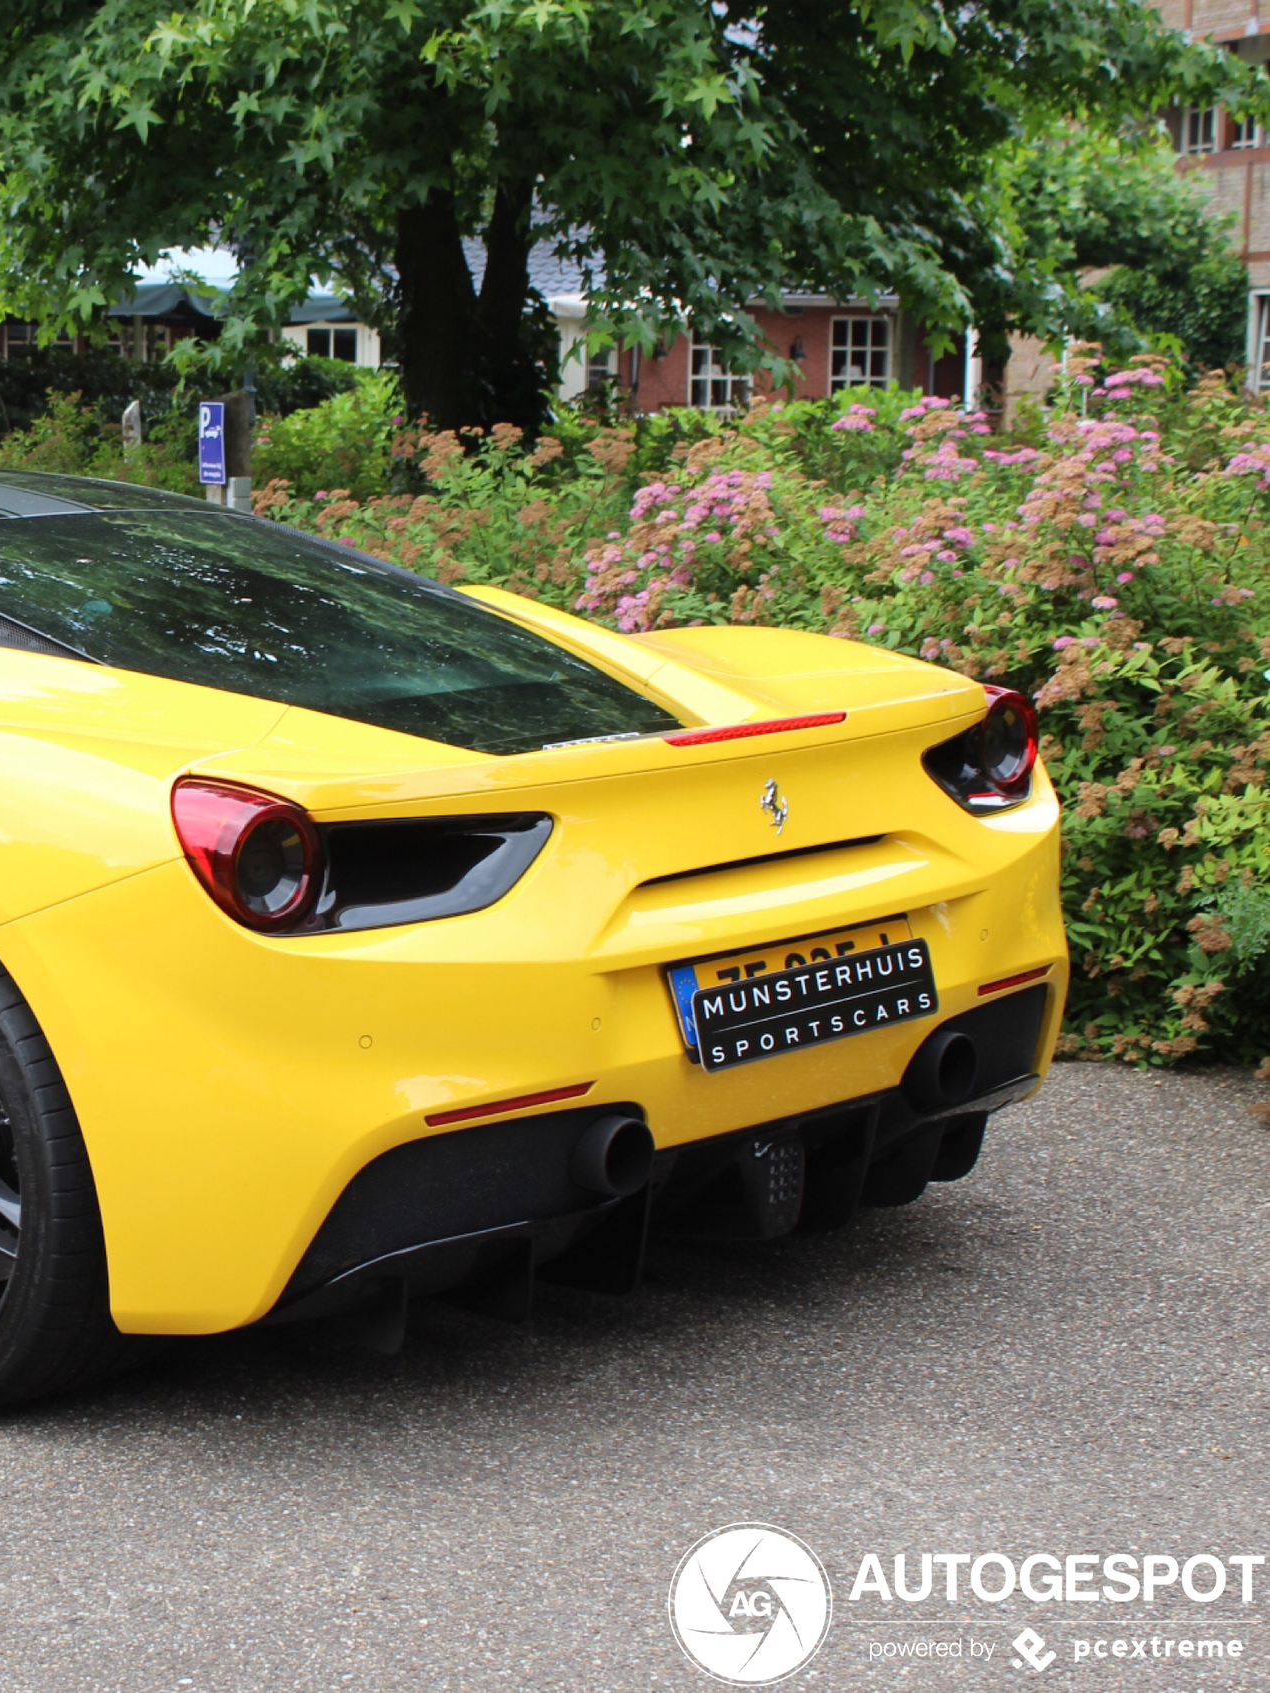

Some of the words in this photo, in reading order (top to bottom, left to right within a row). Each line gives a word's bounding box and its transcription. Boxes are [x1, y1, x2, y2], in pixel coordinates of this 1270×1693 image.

[201, 406, 211, 438] P
[703, 947, 924, 1019] MUNSTERHUIS
[712, 993, 931, 1063] SPORTSCARS
